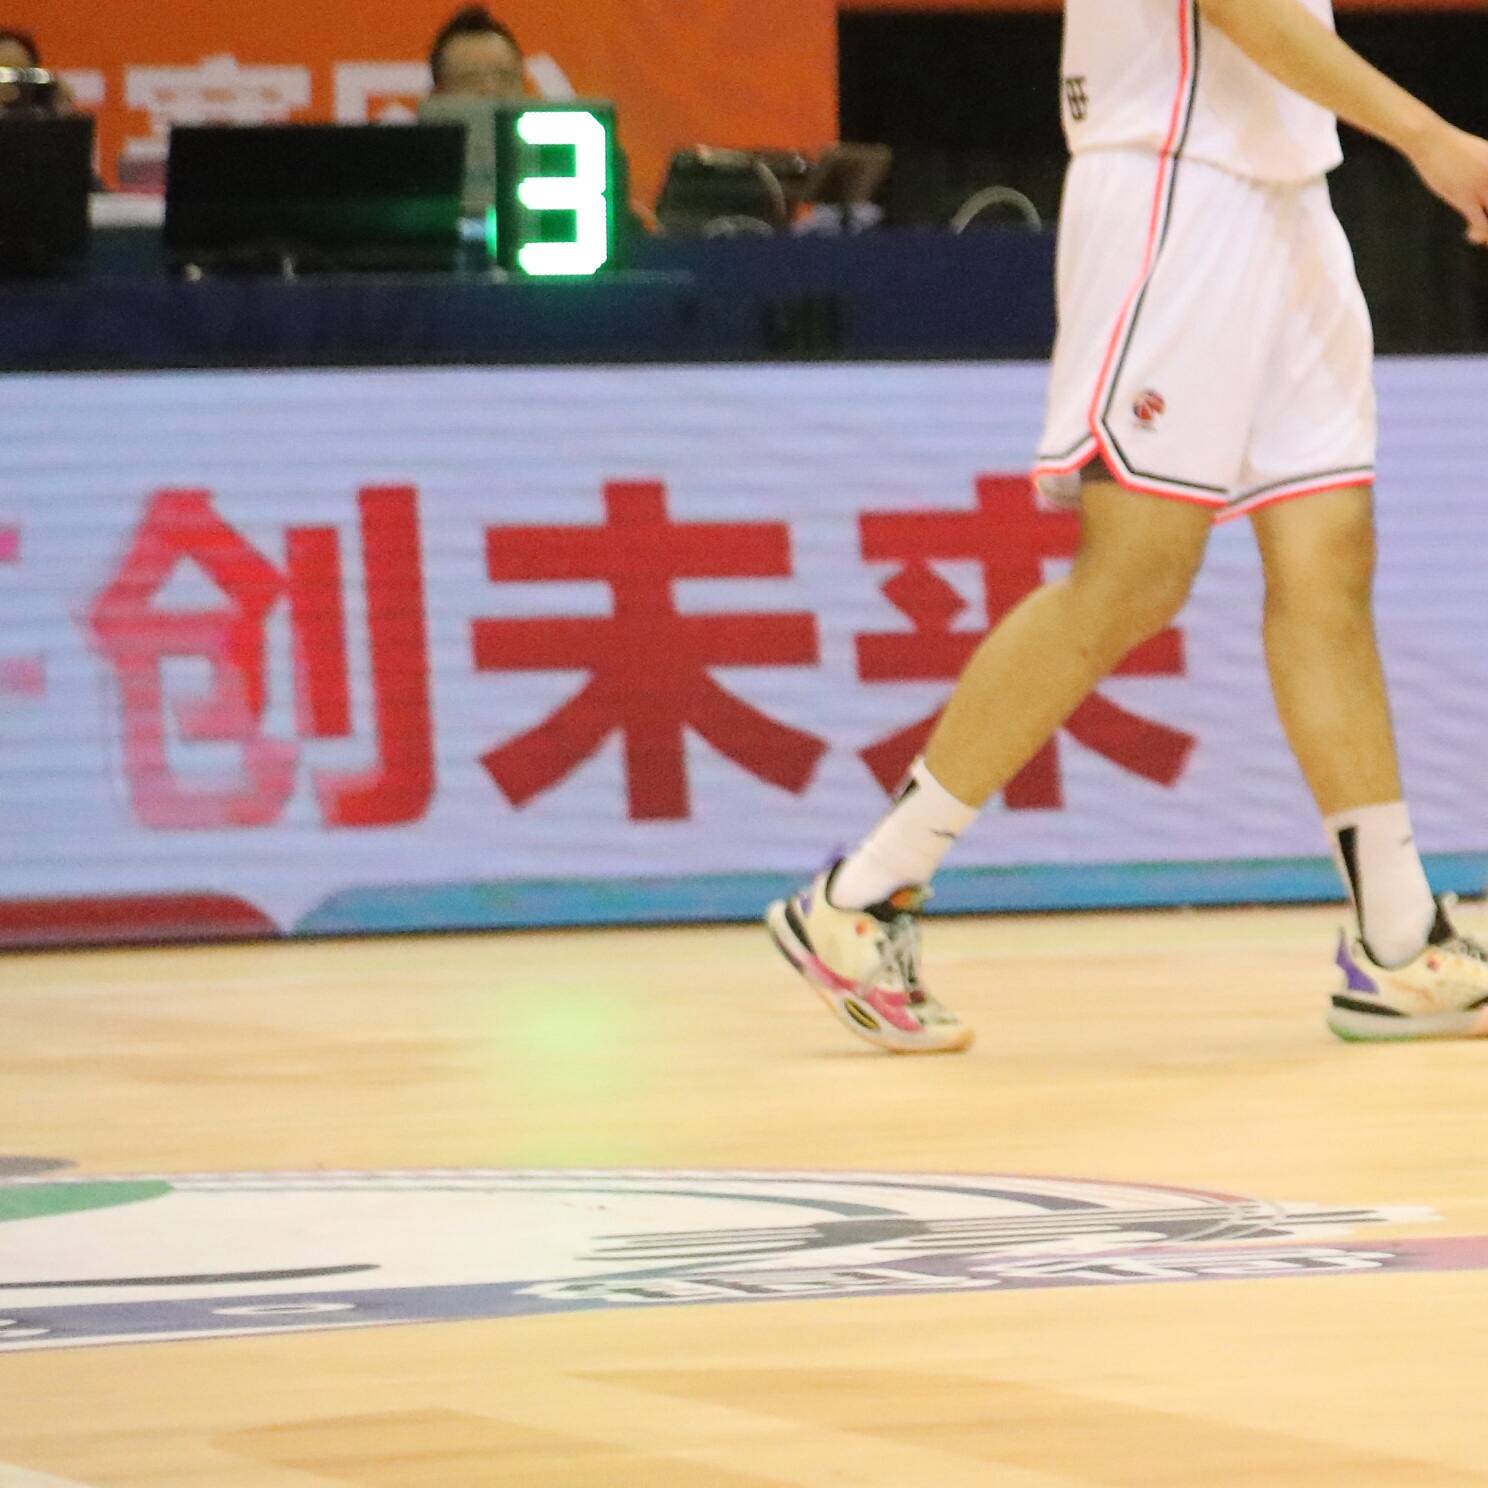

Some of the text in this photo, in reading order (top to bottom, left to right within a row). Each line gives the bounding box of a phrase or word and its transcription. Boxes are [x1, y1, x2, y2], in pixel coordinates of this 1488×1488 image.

[516, 111, 608, 277] 3
[0, 472, 1198, 830] 创未来
